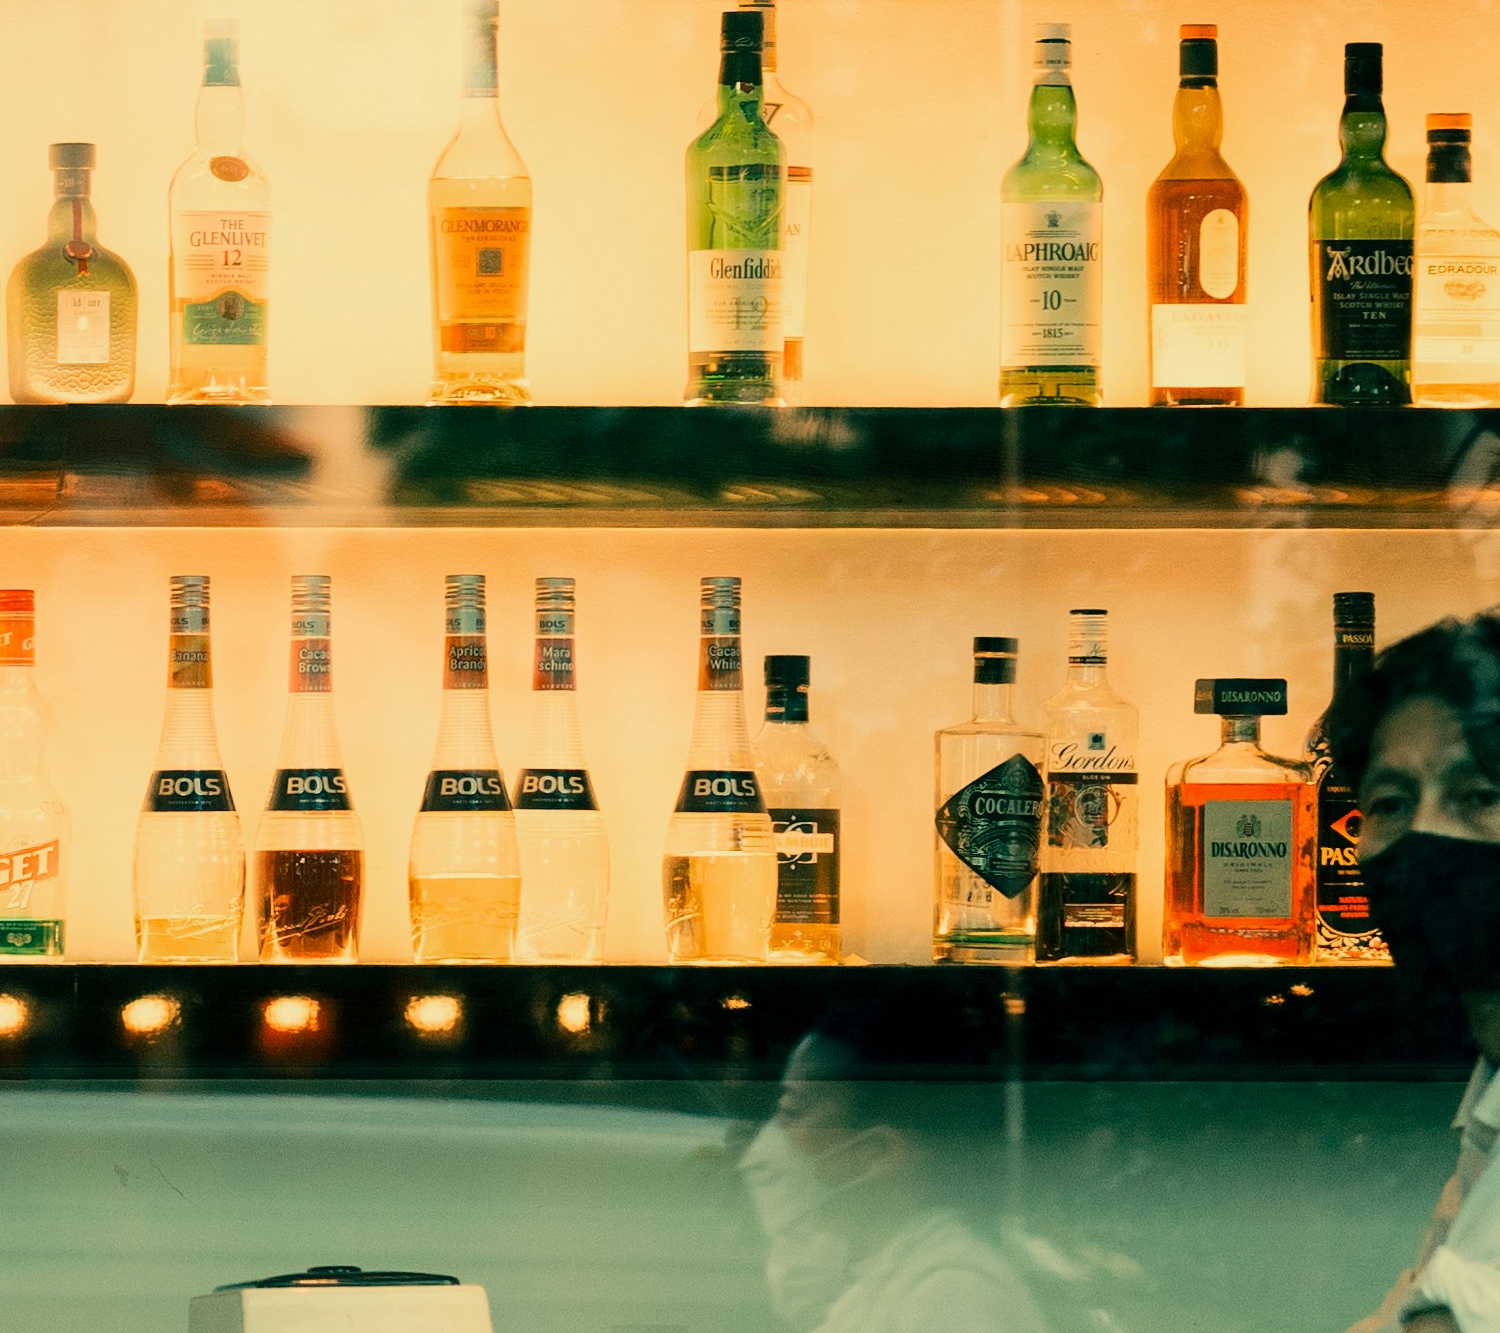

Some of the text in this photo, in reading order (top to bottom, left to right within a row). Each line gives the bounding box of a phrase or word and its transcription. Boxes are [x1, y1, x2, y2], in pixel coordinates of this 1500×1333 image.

[219, 219, 245, 231] THE
[189, 231, 267, 248] GLENLIVET
[220, 249, 243, 267] 12
[1005, 242, 1099, 262] LAPHROAIG
[1427, 264, 1498, 276] EDRADOUR
[1041, 289, 1062, 311] 10
[1332, 291, 1357, 301] ISLAY
[1358, 291, 1390, 301] SINGLE
[730, 295, 770, 332] 12
[1361, 310, 1387, 321] TEN
[1041, 328, 1065, 339] 1815
[171, 650, 209, 663] Banana
[541, 646, 571, 659] Mara
[1221, 689, 1282, 703] DISARONNO
[1049, 741, 1137, 771] Gordon's
[158, 777, 222, 797] BOLS
[286, 776, 346, 795] BOLS
[440, 776, 503, 798] BOLS
[522, 776, 585, 794] BOLS
[693, 778, 756, 797] BOLS
[776, 837, 831, 848] AMBUIE
[1210, 841, 1287, 860] DISARONNO
[1319, 846, 1360, 866] PAS
[6, 879, 35, 910] 27
